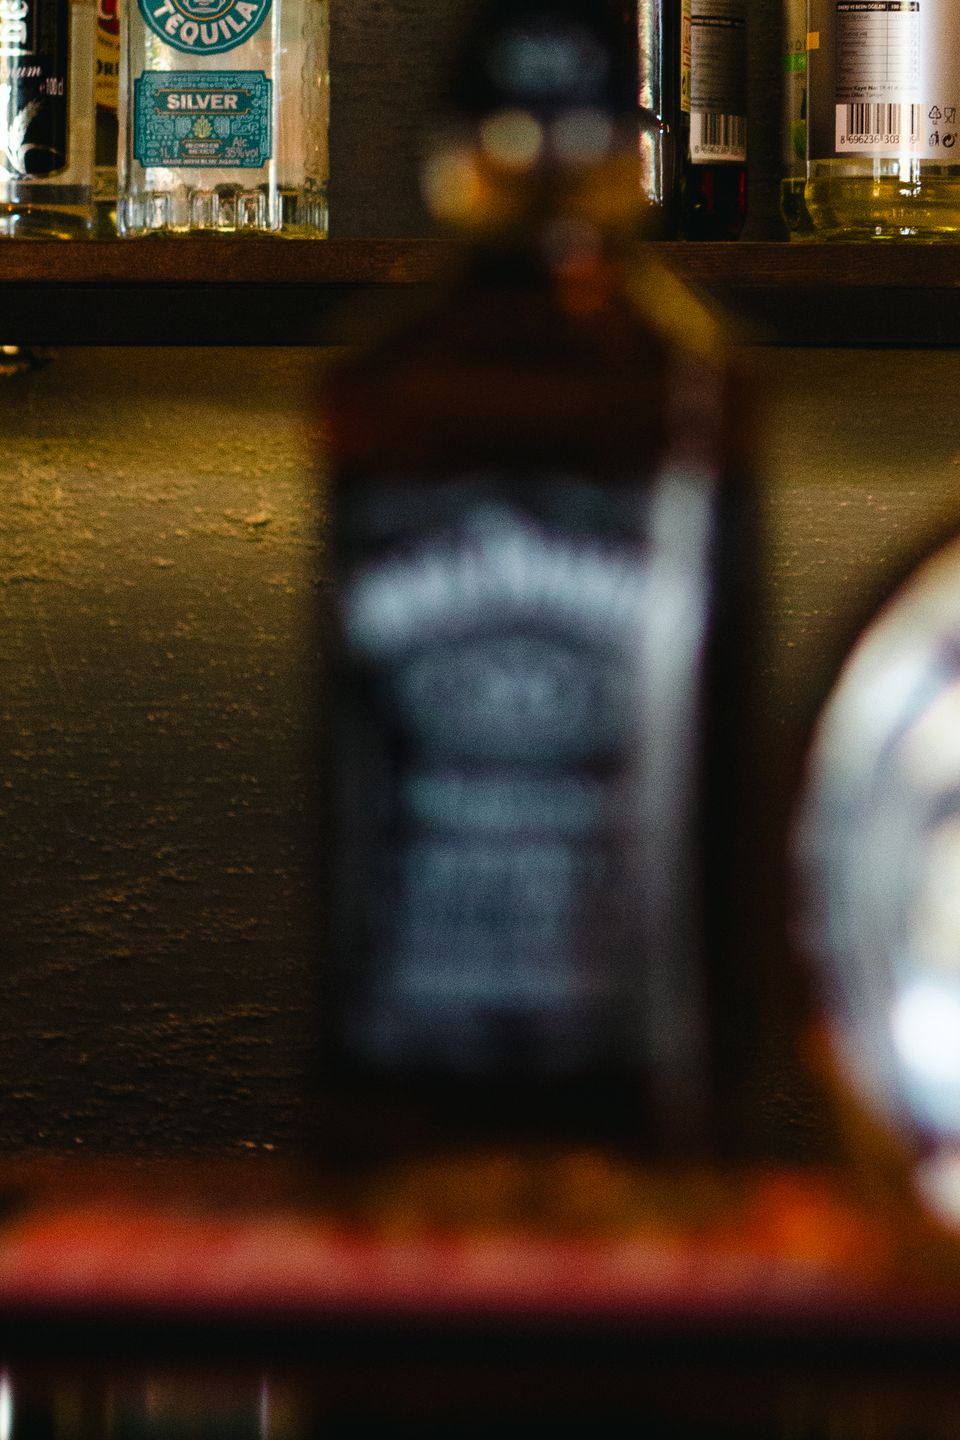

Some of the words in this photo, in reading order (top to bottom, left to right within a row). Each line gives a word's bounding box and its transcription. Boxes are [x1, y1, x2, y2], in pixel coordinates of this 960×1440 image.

[167, 94, 238, 110] SILVER
[840, 135, 846, 144] 8
[848, 135, 880, 144] 696236
